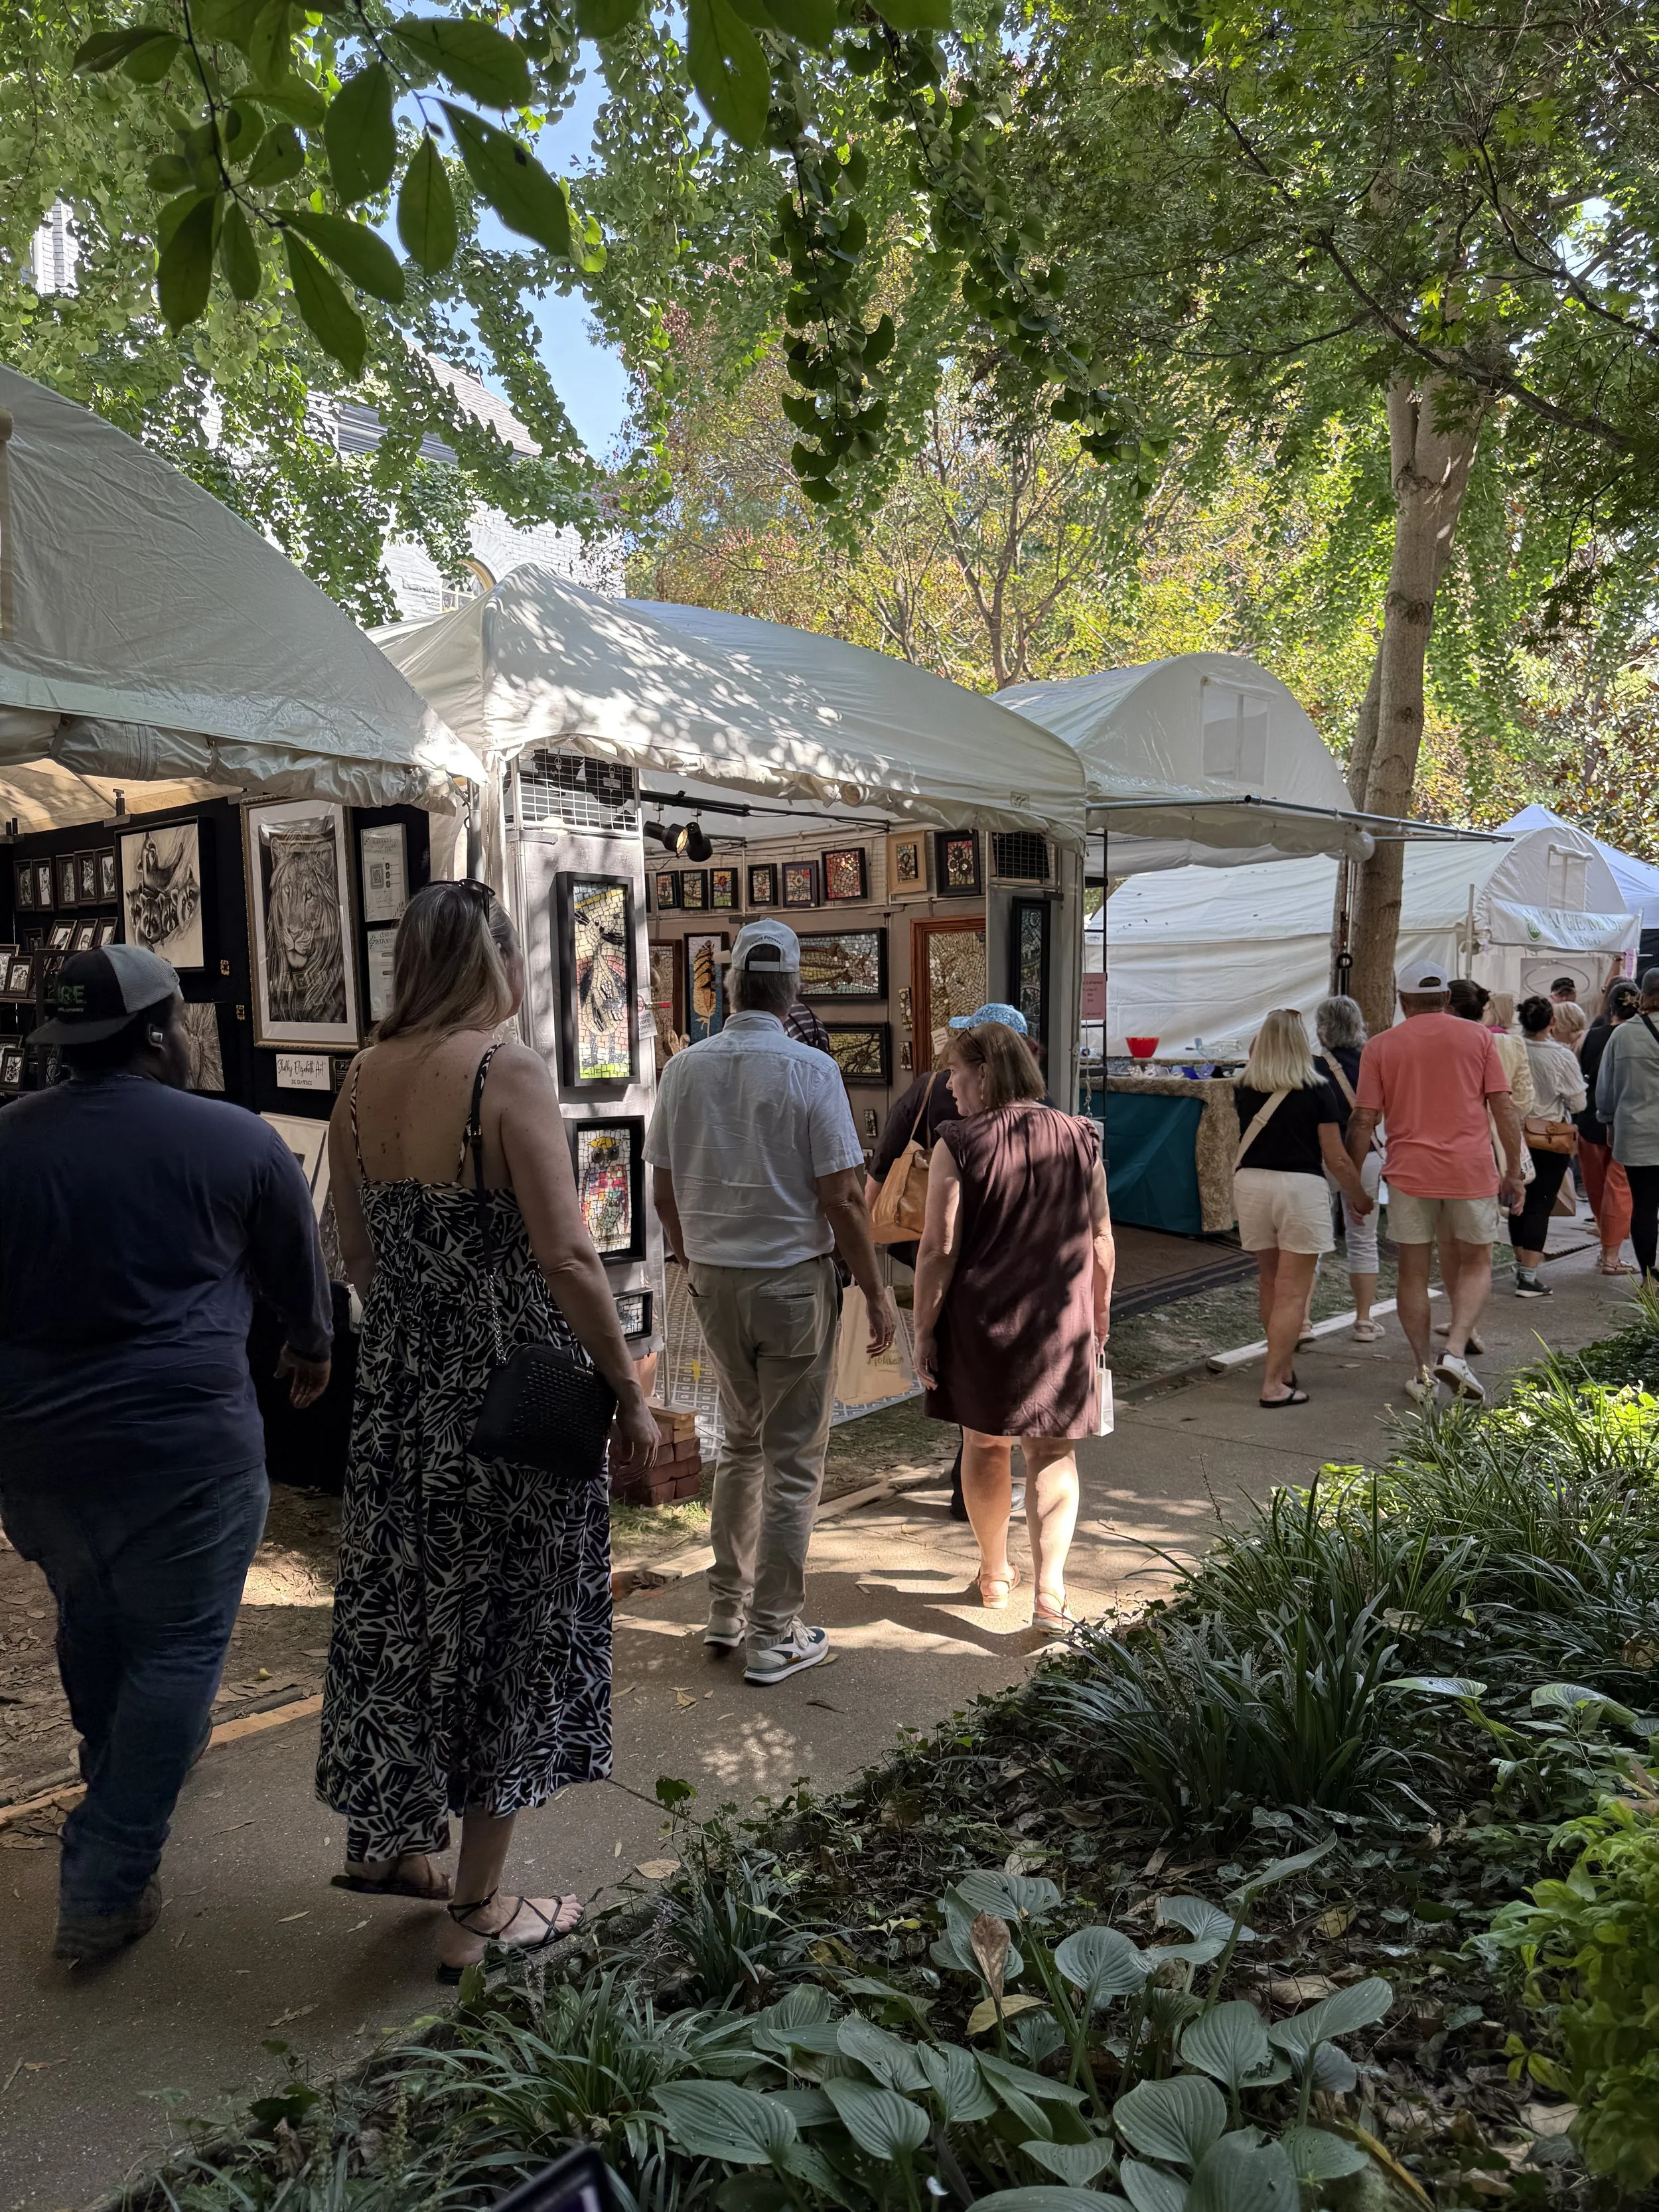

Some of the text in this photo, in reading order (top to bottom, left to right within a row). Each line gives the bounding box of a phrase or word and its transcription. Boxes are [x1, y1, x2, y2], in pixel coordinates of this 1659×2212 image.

[277, 1059, 293, 1077] Shelby
[295, 1060, 314, 1076] Elizabeth
[315, 1061, 326, 1078] Art
